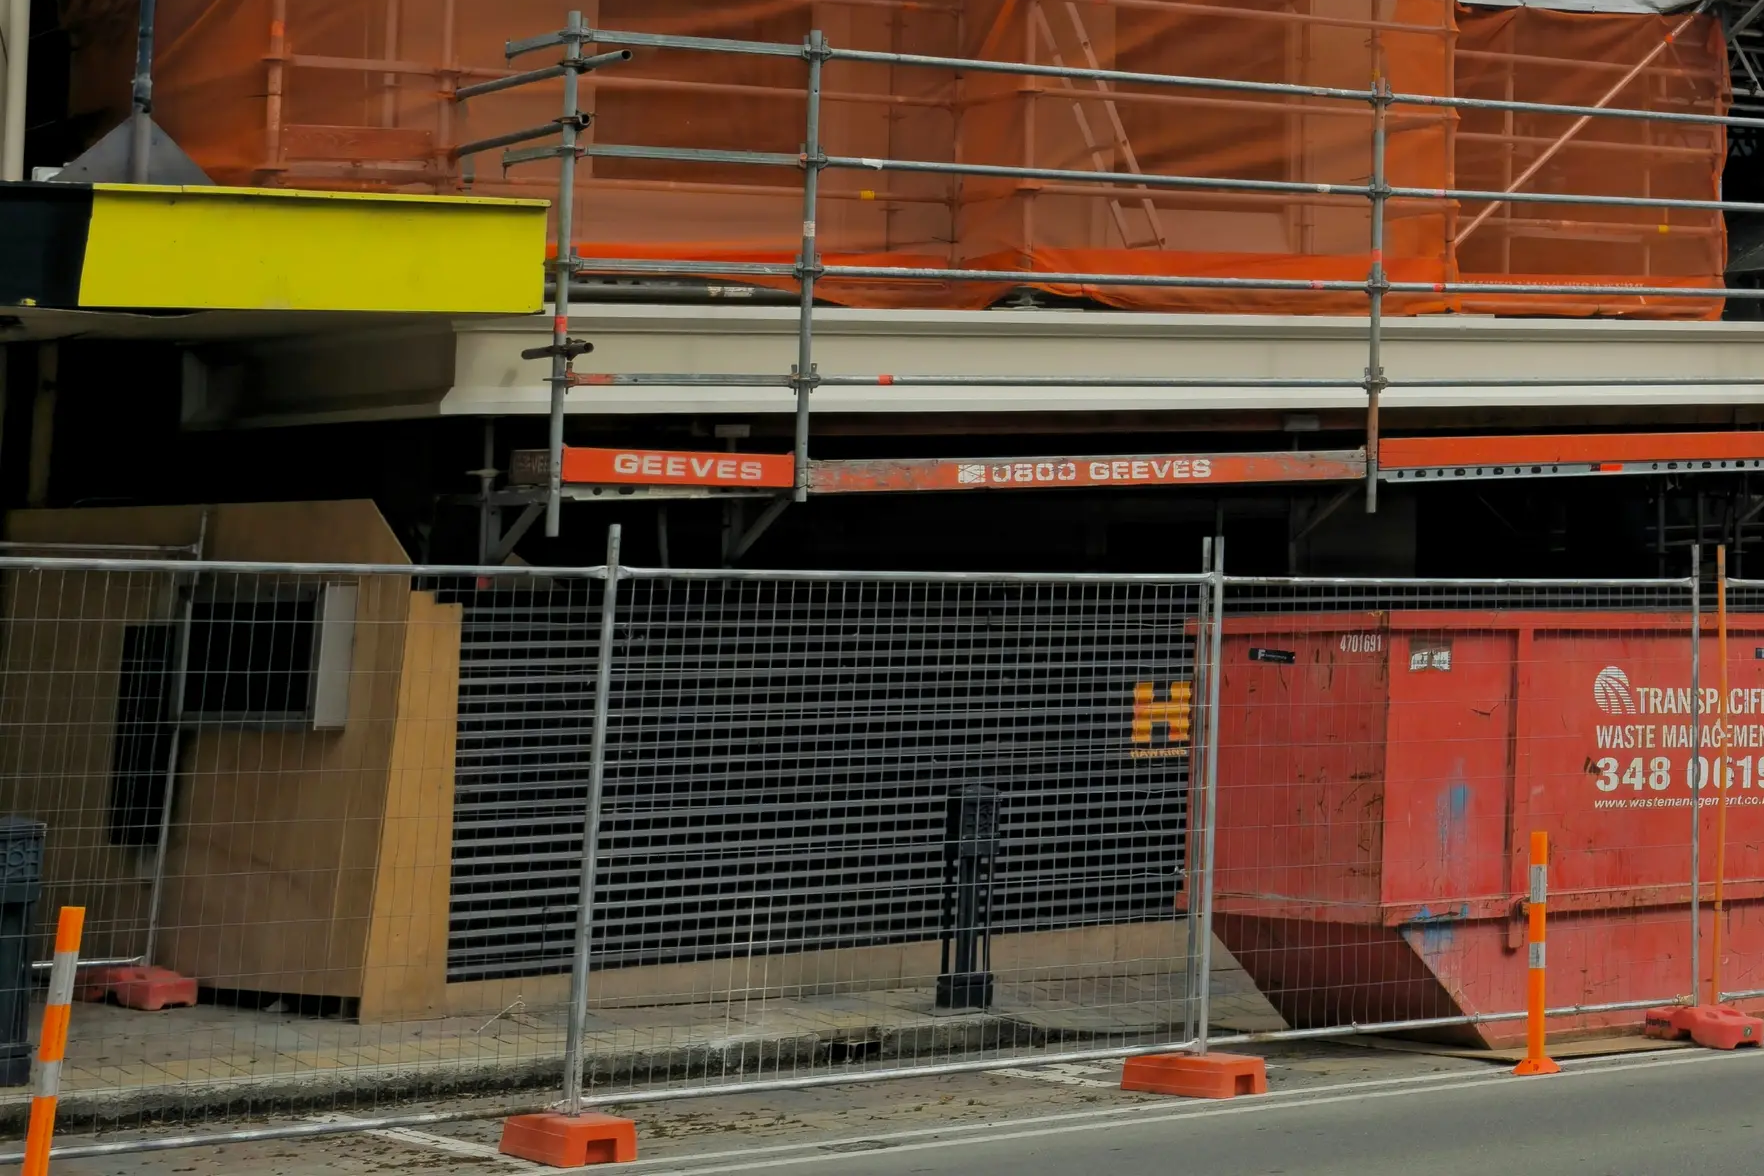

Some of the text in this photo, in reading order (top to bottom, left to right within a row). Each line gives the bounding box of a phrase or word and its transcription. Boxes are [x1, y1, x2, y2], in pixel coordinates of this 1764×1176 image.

[612, 451, 764, 482] GEEVES
[991, 458, 1214, 484] 0800 GEEVES
[1340, 634, 1382, 653] 4701691
[1131, 680, 1192, 743] H
[1596, 725, 1656, 749] WASTE
[1596, 756, 1671, 792] 348
